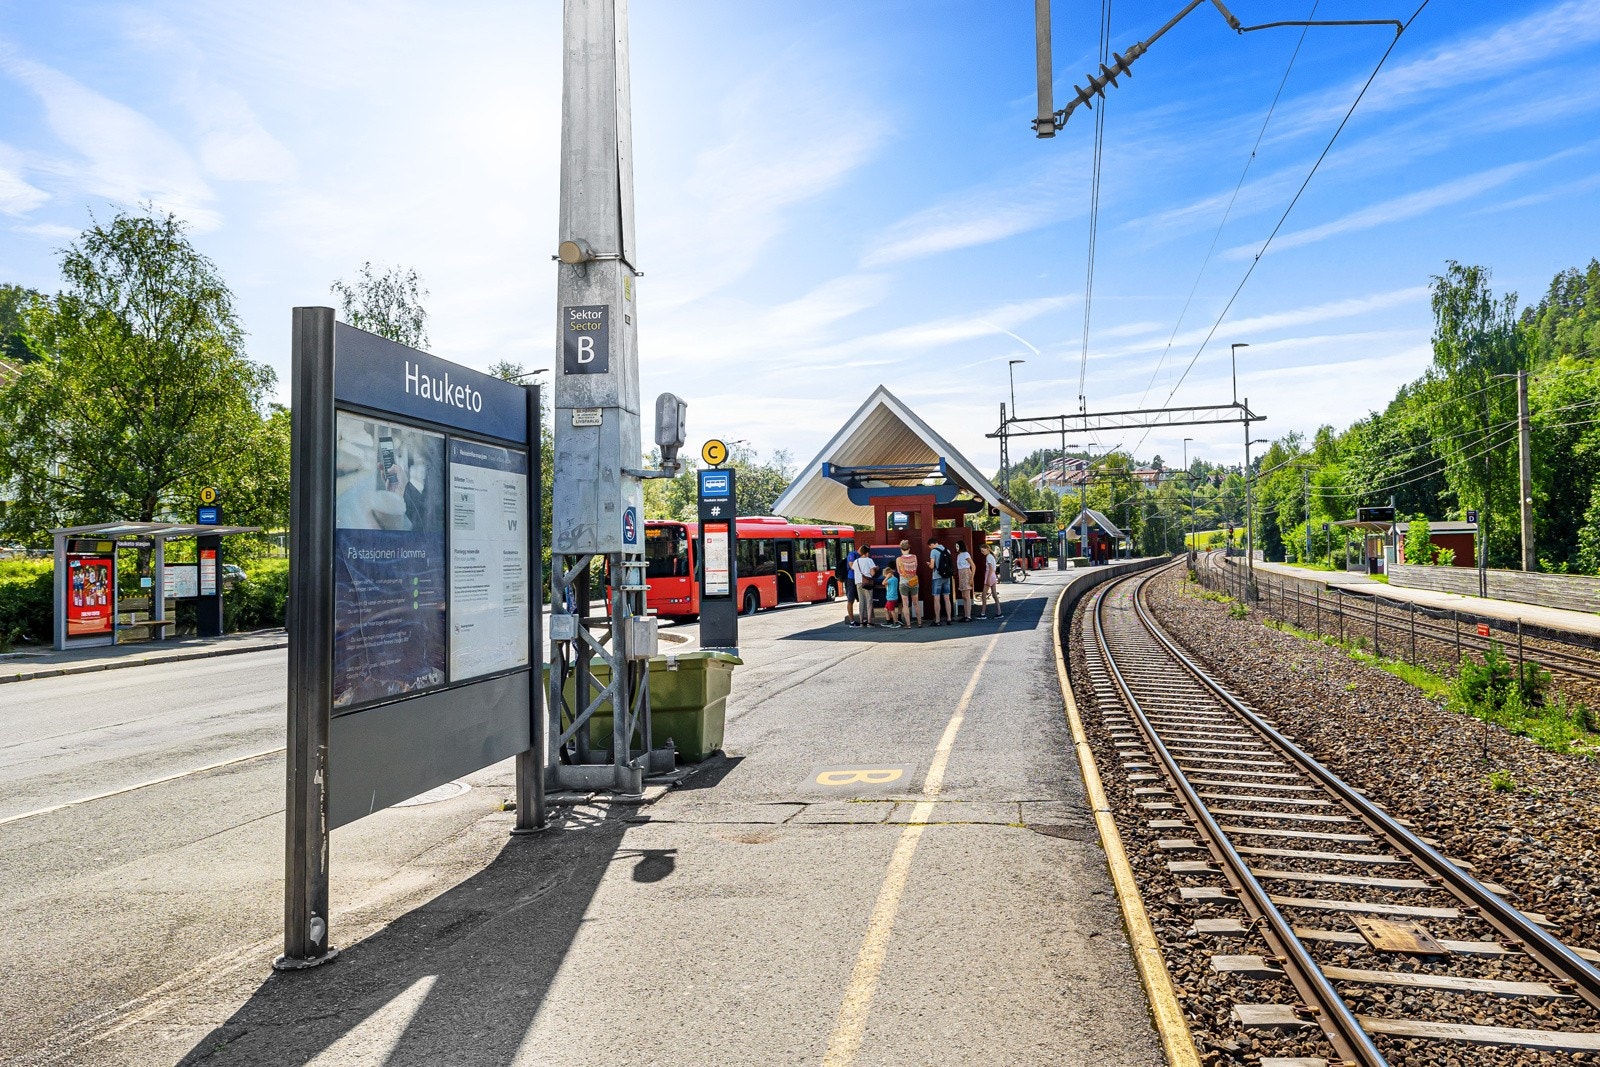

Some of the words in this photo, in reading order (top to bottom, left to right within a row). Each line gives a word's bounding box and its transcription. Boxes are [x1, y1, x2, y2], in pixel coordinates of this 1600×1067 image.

[570, 309, 602, 320] Sektor
[570, 321, 601, 331] Sector
[577, 335, 595, 364] B
[405, 360, 482, 413] Hauketo
[708, 445, 718, 459] C
[205, 490, 212, 500] B
[347, 546, 358, 560] Få
[359, 547, 396, 562] stasjonen
[400, 547, 426, 560] lomma
[815, 768, 903, 786] B
